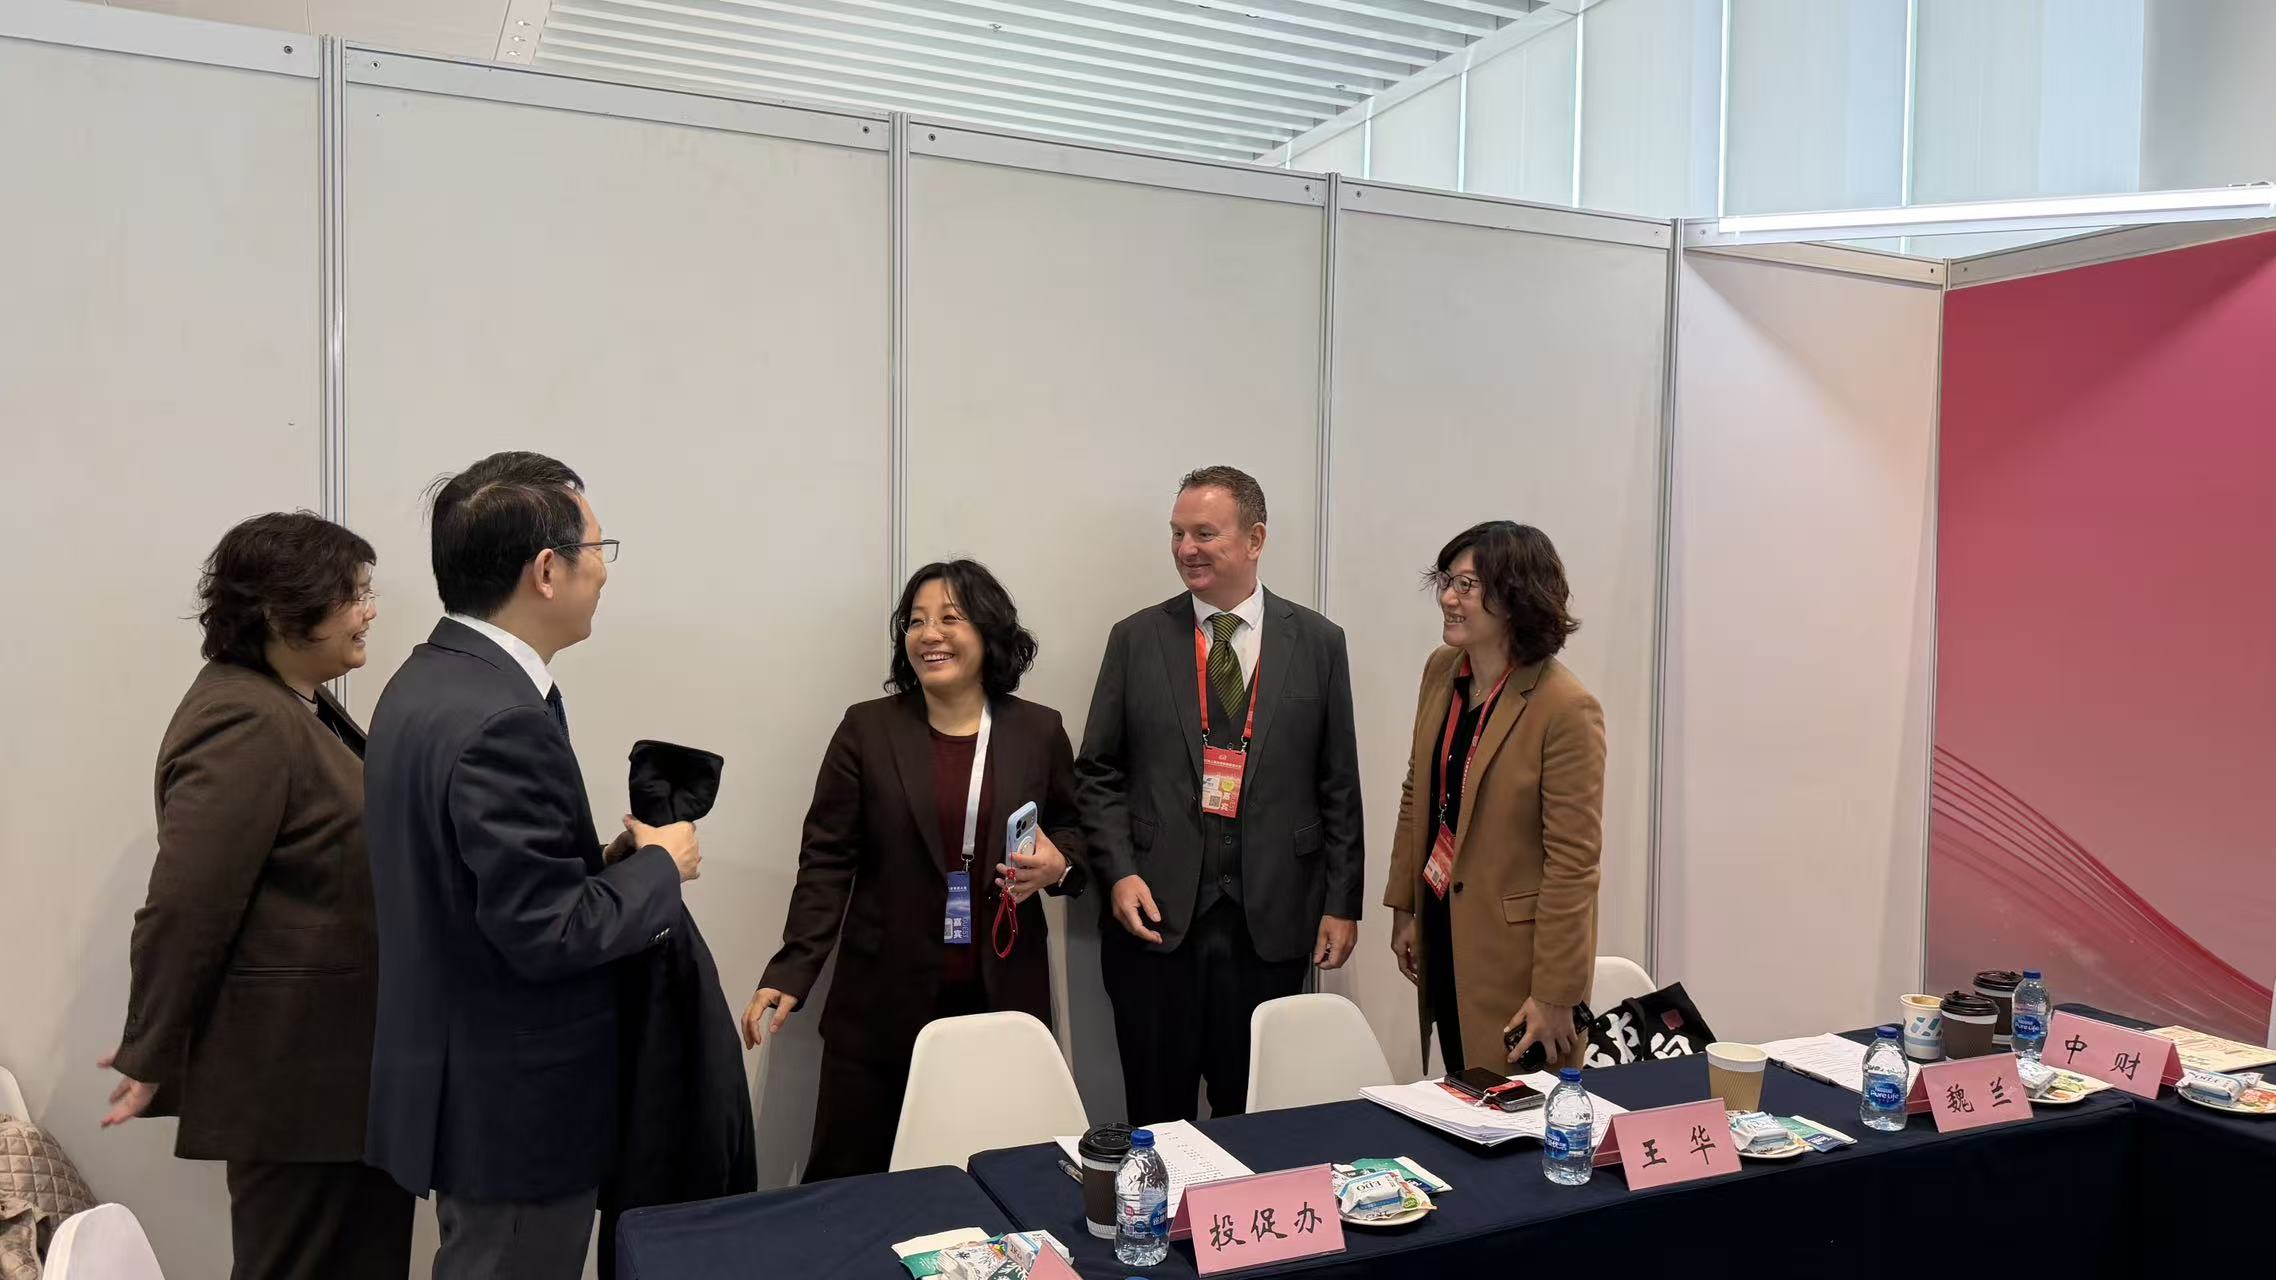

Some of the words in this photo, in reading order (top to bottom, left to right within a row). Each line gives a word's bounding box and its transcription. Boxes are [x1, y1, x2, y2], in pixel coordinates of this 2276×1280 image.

[2065, 1034, 2142, 1081] 中财
[1870, 1089, 1887, 1098] Pure
[1888, 1094, 1900, 1102] Life
[1946, 1076, 2012, 1114] 魏兰
[1642, 1124, 1716, 1168] 王华
[1356, 1180, 1382, 1192] EDO
[1209, 1201, 1322, 1252] 投促办
